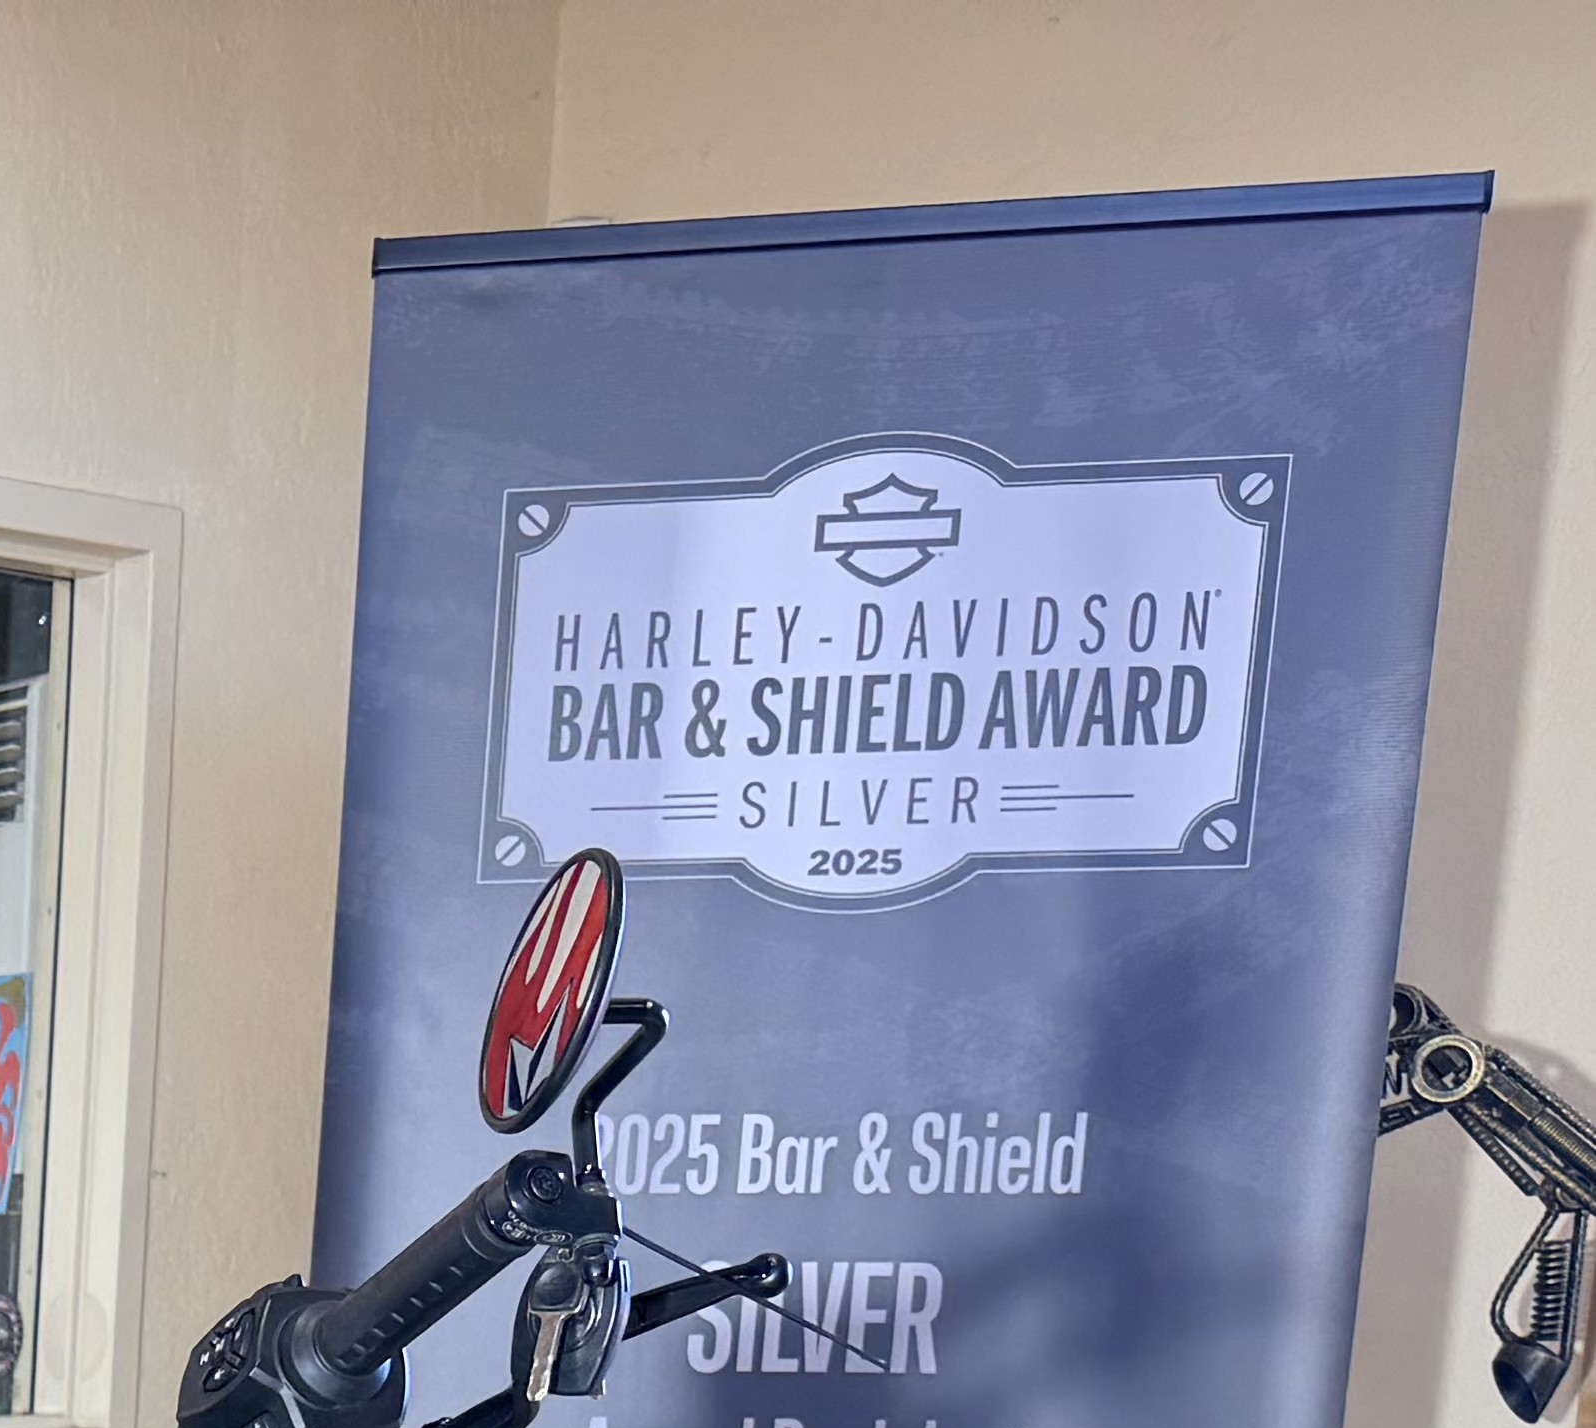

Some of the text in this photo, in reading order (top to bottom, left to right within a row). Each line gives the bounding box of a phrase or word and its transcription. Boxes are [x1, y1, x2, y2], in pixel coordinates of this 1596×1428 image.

[554, 589, 1211, 672] HARLEY-DAVIDSON
[546, 665, 1209, 763] BAR & SHIELD AWARD
[738, 776, 983, 830] SILVER
[807, 847, 903, 877] 2025
[736, 1113, 838, 1196] Bar
[851, 1113, 891, 1196] &
[909, 1111, 1088, 1197] Shield
[686, 1259, 945, 1376] SILVER
